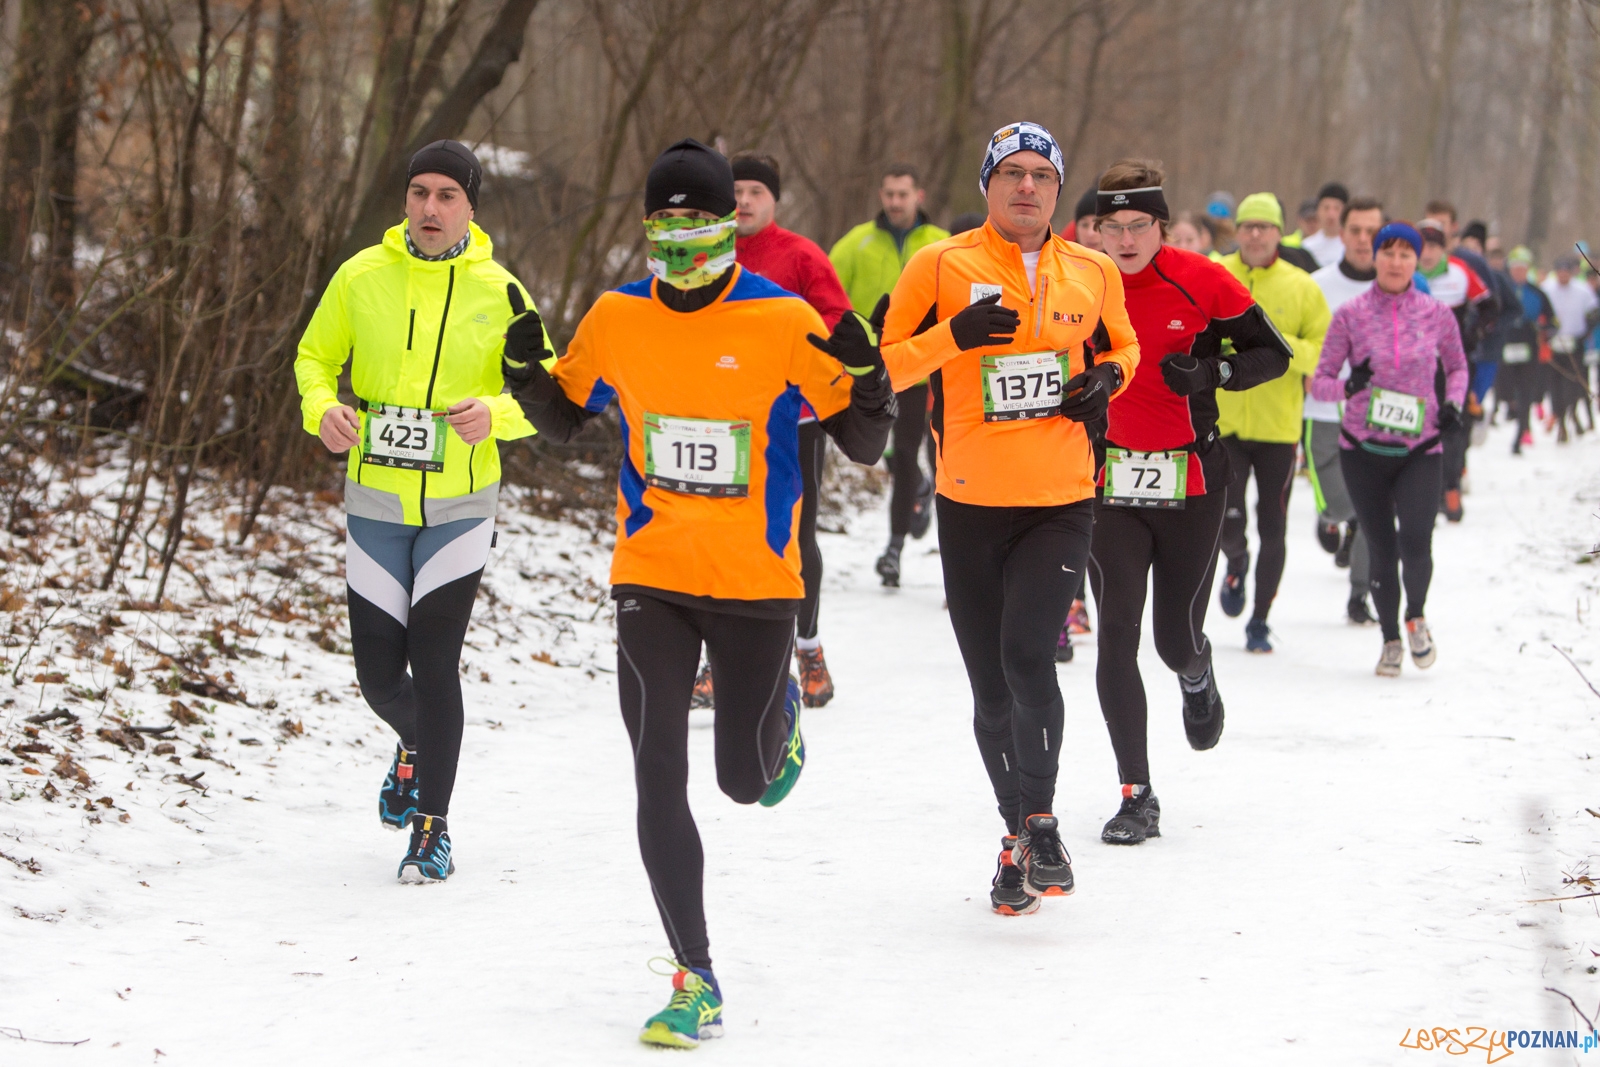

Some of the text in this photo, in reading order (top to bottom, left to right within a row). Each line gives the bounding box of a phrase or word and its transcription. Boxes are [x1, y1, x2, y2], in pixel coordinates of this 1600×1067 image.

[668, 193, 687, 204] 4F
[996, 370, 1061, 401] 1375
[1035, 398, 1060, 407] STEFAN
[1379, 403, 1414, 423] 1734
[379, 423, 428, 451] 423
[388, 449, 415, 458] ANDRZEJ
[671, 441, 718, 472] 113
[1131, 467, 1162, 490] 72
